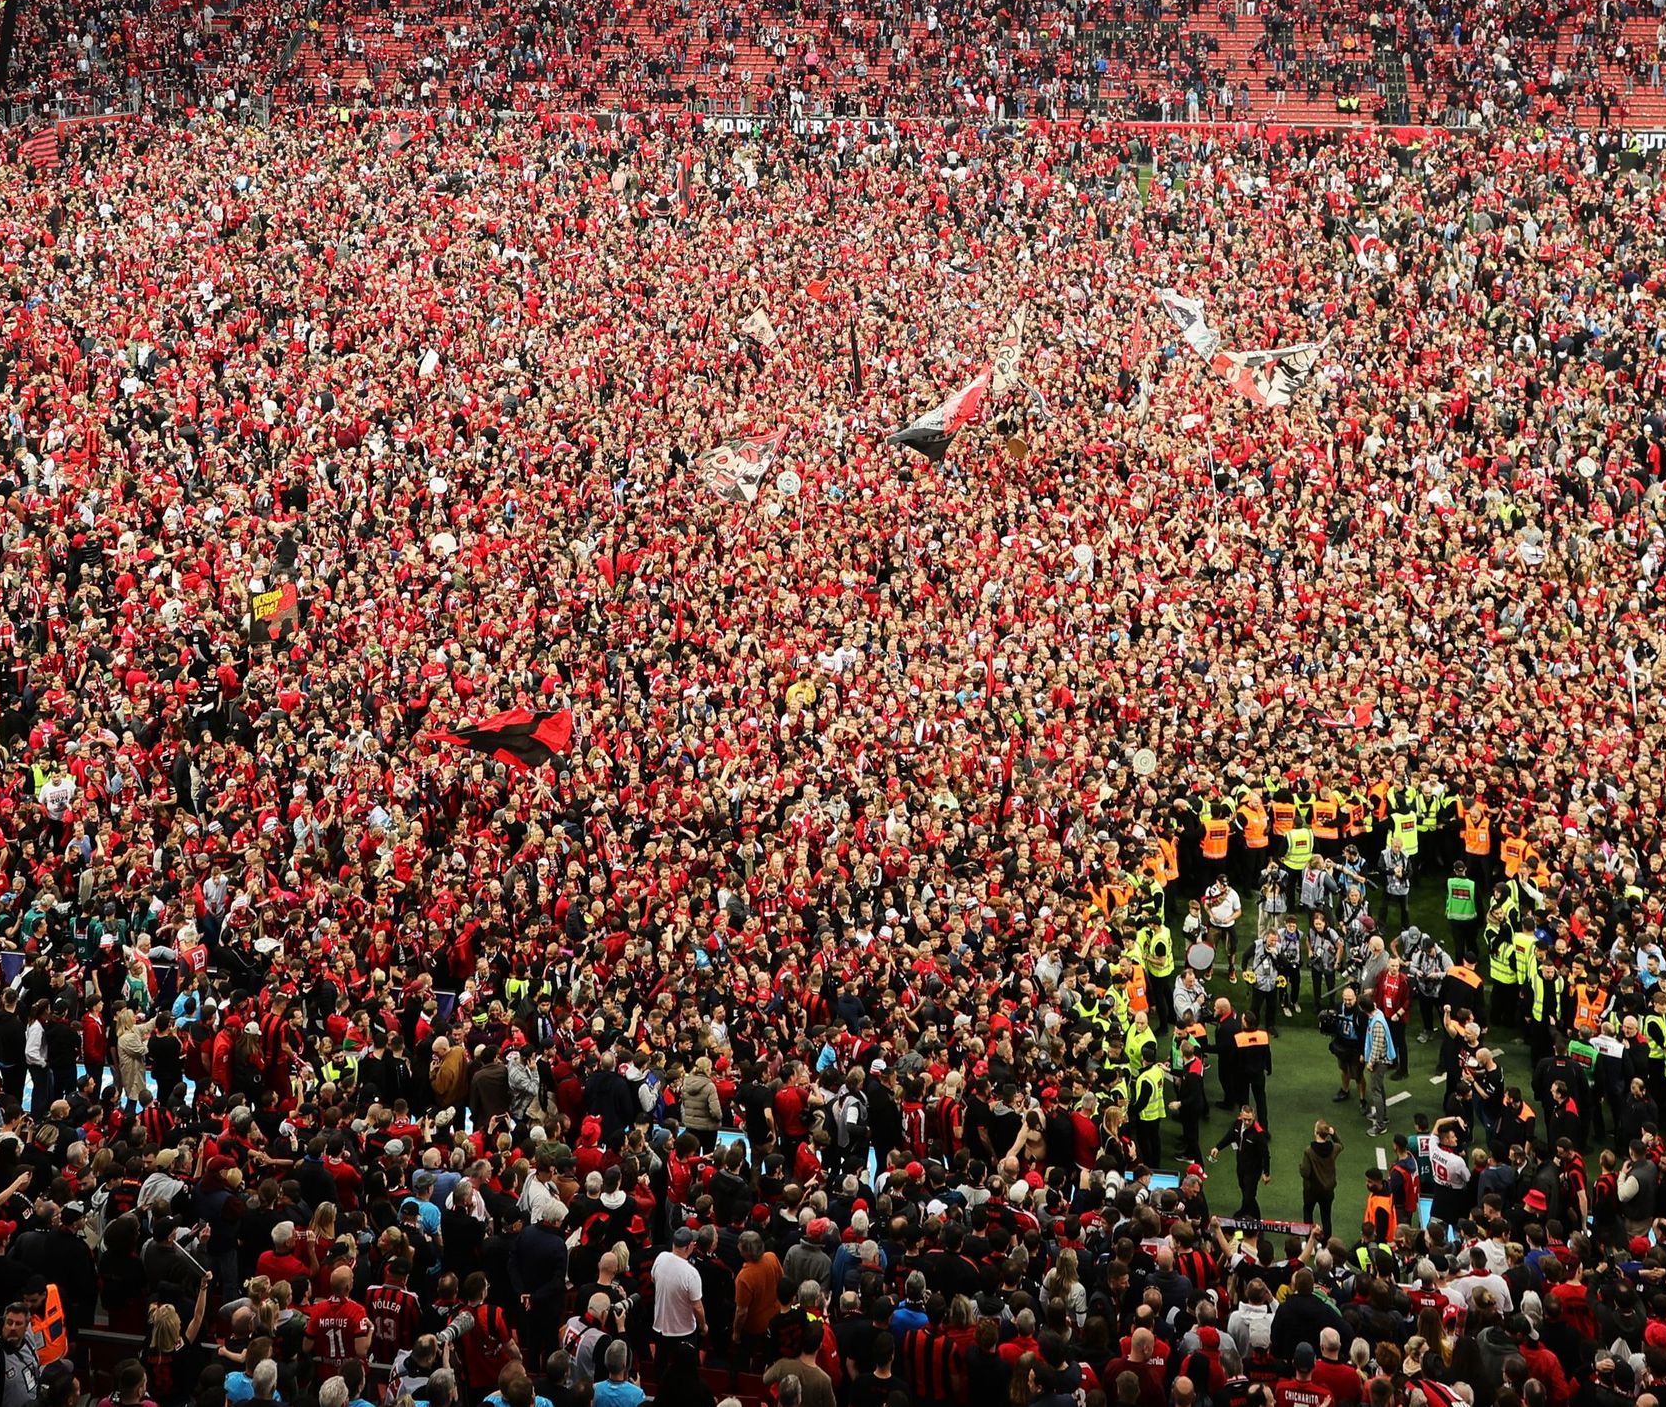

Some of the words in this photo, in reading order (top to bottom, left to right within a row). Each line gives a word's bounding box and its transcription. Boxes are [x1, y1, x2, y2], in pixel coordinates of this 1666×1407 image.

[1435, 1165, 1450, 1181] 19
[372, 1297, 401, 1314] VÖLLER
[374, 1318, 395, 1342] 13
[325, 1328, 345, 1358] 11
[1285, 1389, 1319, 1404] CHICHARITO
